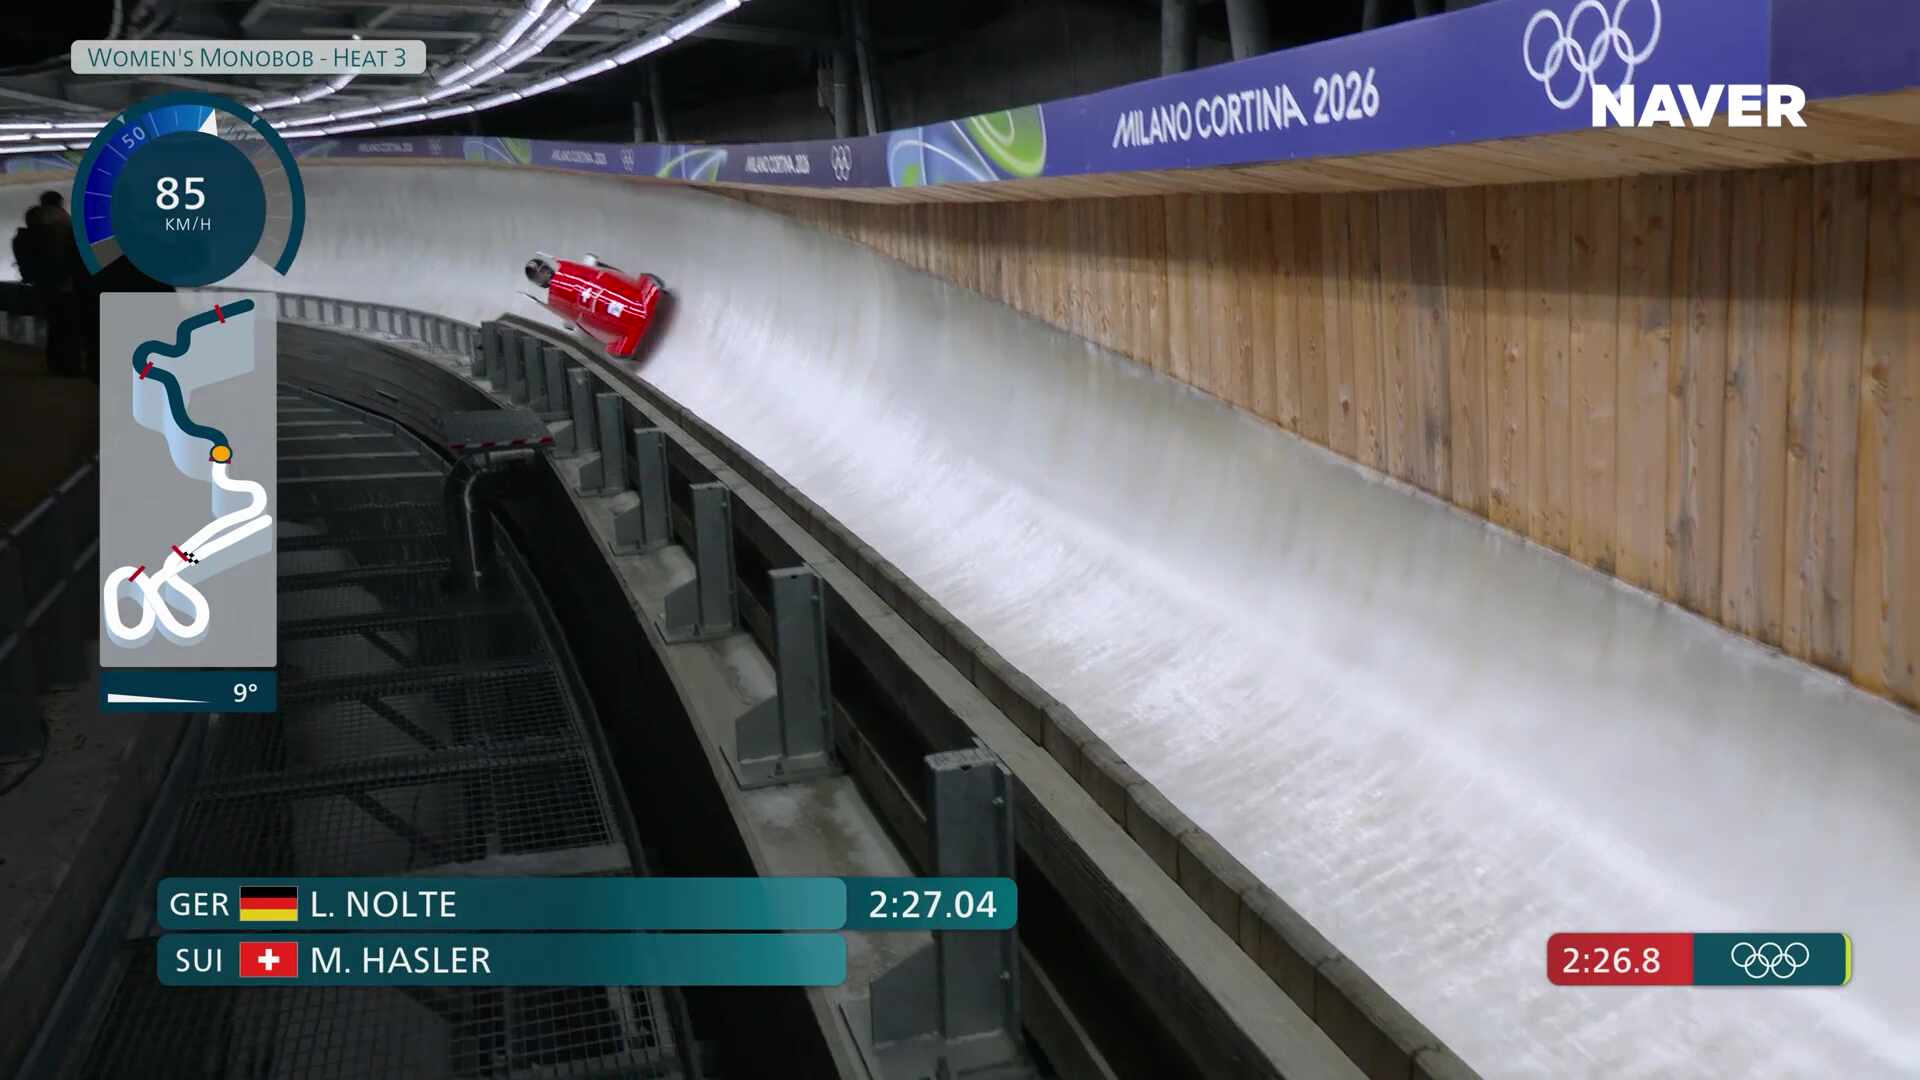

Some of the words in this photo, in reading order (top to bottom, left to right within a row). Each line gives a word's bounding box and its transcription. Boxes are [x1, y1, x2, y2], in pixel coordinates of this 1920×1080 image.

[1112, 101, 1192, 148] MILANO
[1195, 84, 1308, 139] CORTINA
[1313, 67, 1380, 124] 2026
